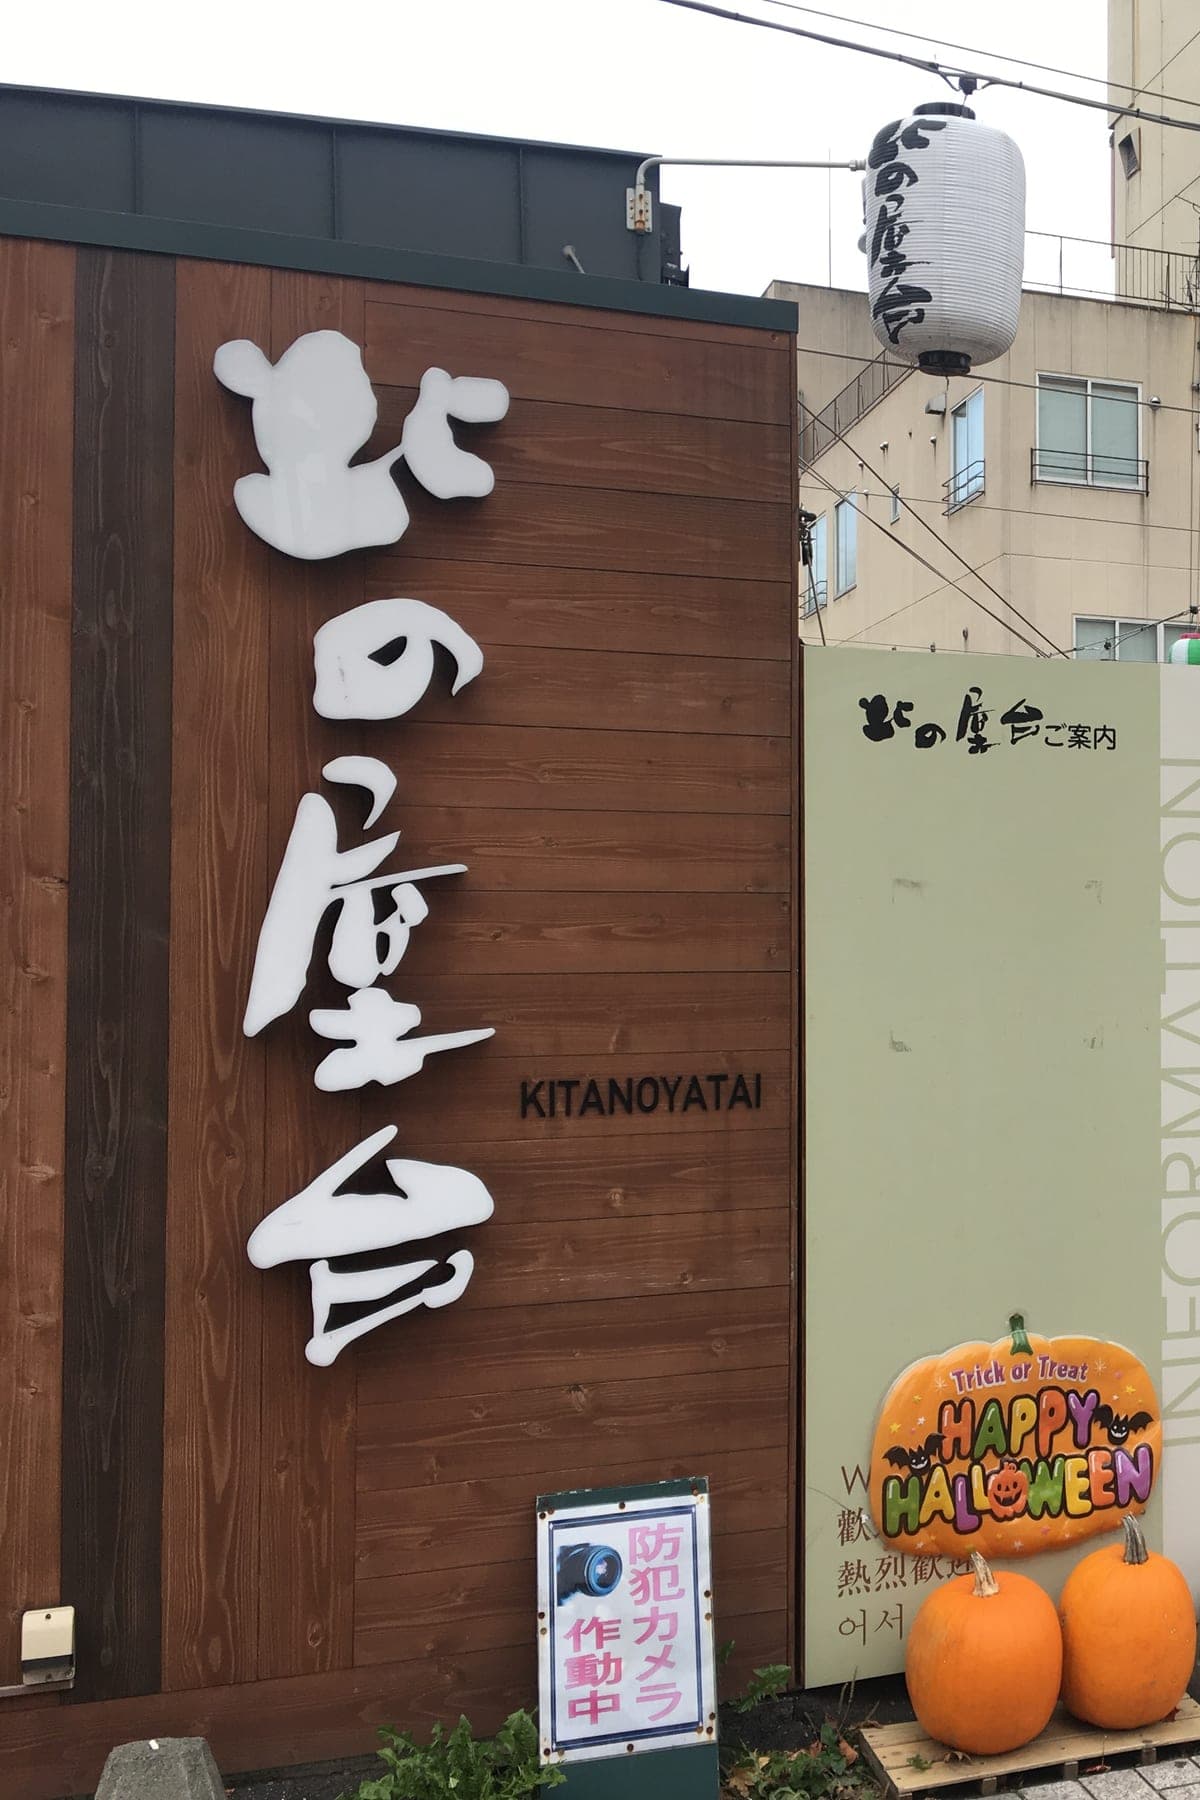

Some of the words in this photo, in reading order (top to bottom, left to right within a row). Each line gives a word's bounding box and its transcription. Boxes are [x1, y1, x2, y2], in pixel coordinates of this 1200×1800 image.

[868, 118, 947, 344] 北の屋台
[213, 328, 510, 1367] 北の屋台
[520, 1073, 762, 1119] KITANOYATAI
[951, 1360, 1005, 1394] Trick
[1011, 1360, 1032, 1381] or
[1037, 1354, 1089, 1382] Treat
[938, 1385, 1100, 1463] HAPPY
[628, 1522, 685, 1721] 防犯カメラ
[838, 1603, 904, 1646] 어서
[564, 1616, 623, 1725] 作動中
